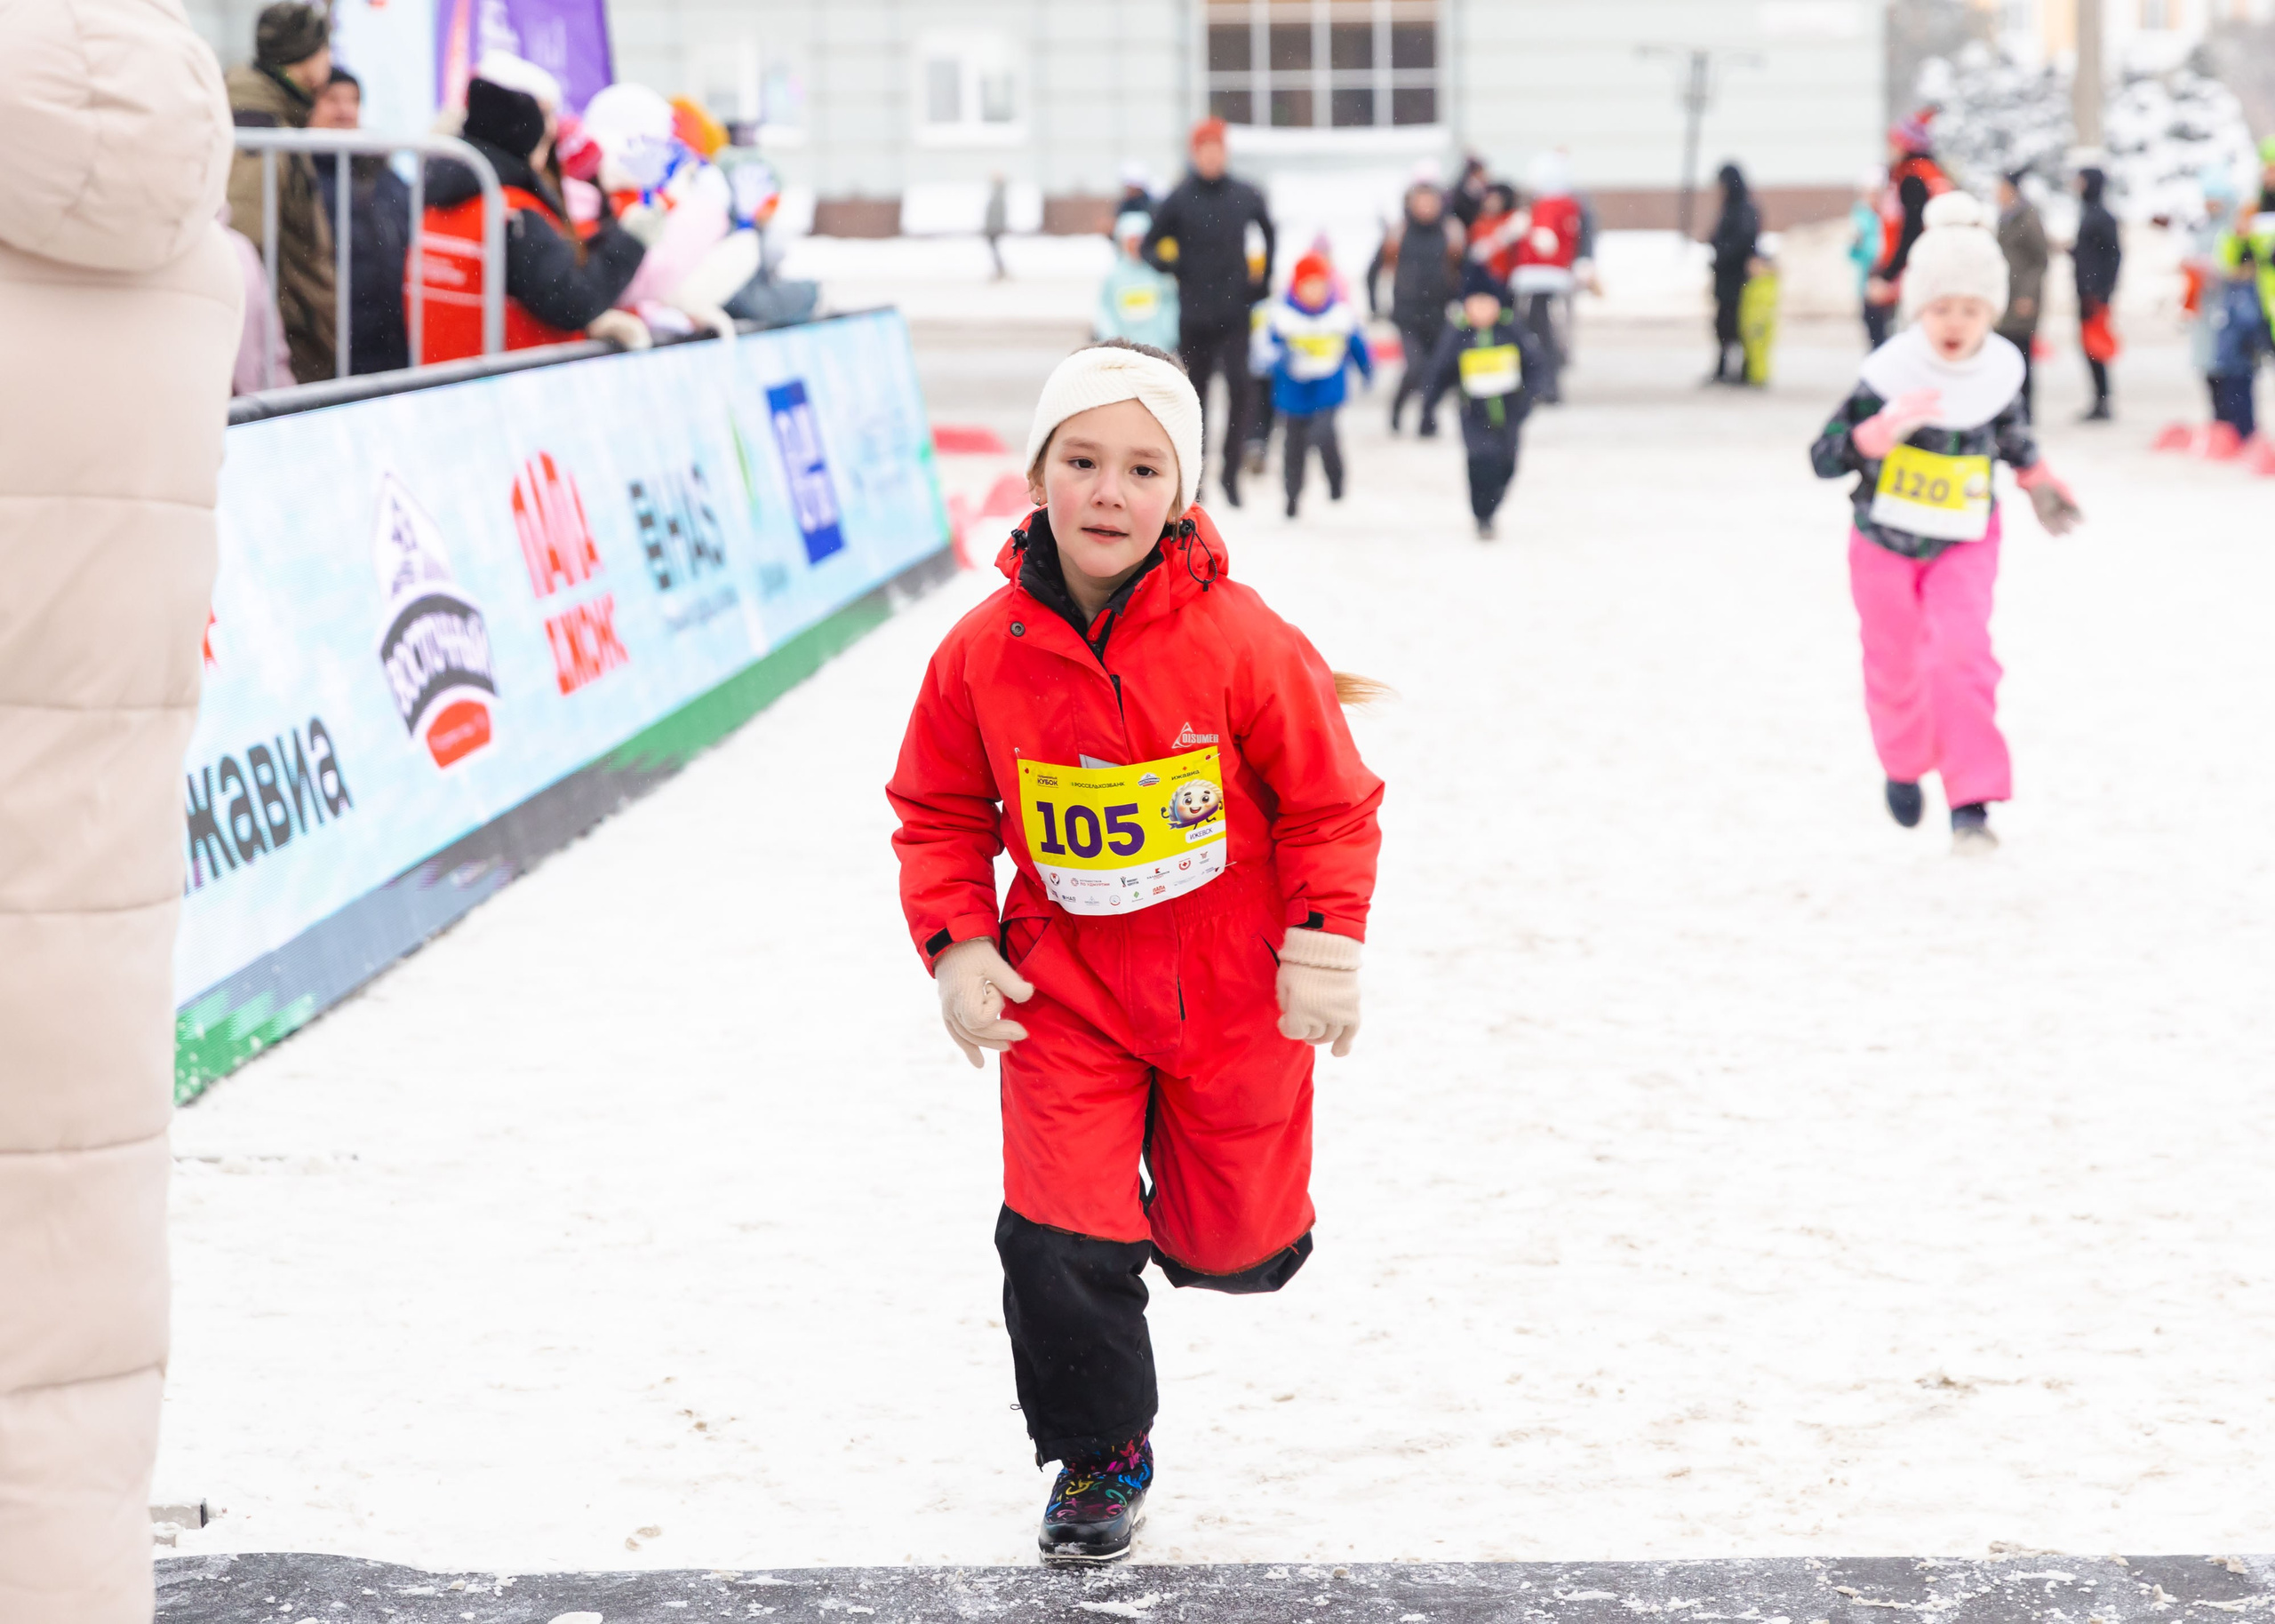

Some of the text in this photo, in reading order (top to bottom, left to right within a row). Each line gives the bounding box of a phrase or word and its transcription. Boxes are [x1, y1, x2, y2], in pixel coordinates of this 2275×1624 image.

[1892, 466, 1951, 504] 120
[185, 718, 354, 896] жавиа
[1036, 800, 1145, 859] 105
[1189, 828, 1213, 840] ИЖЕВСК
